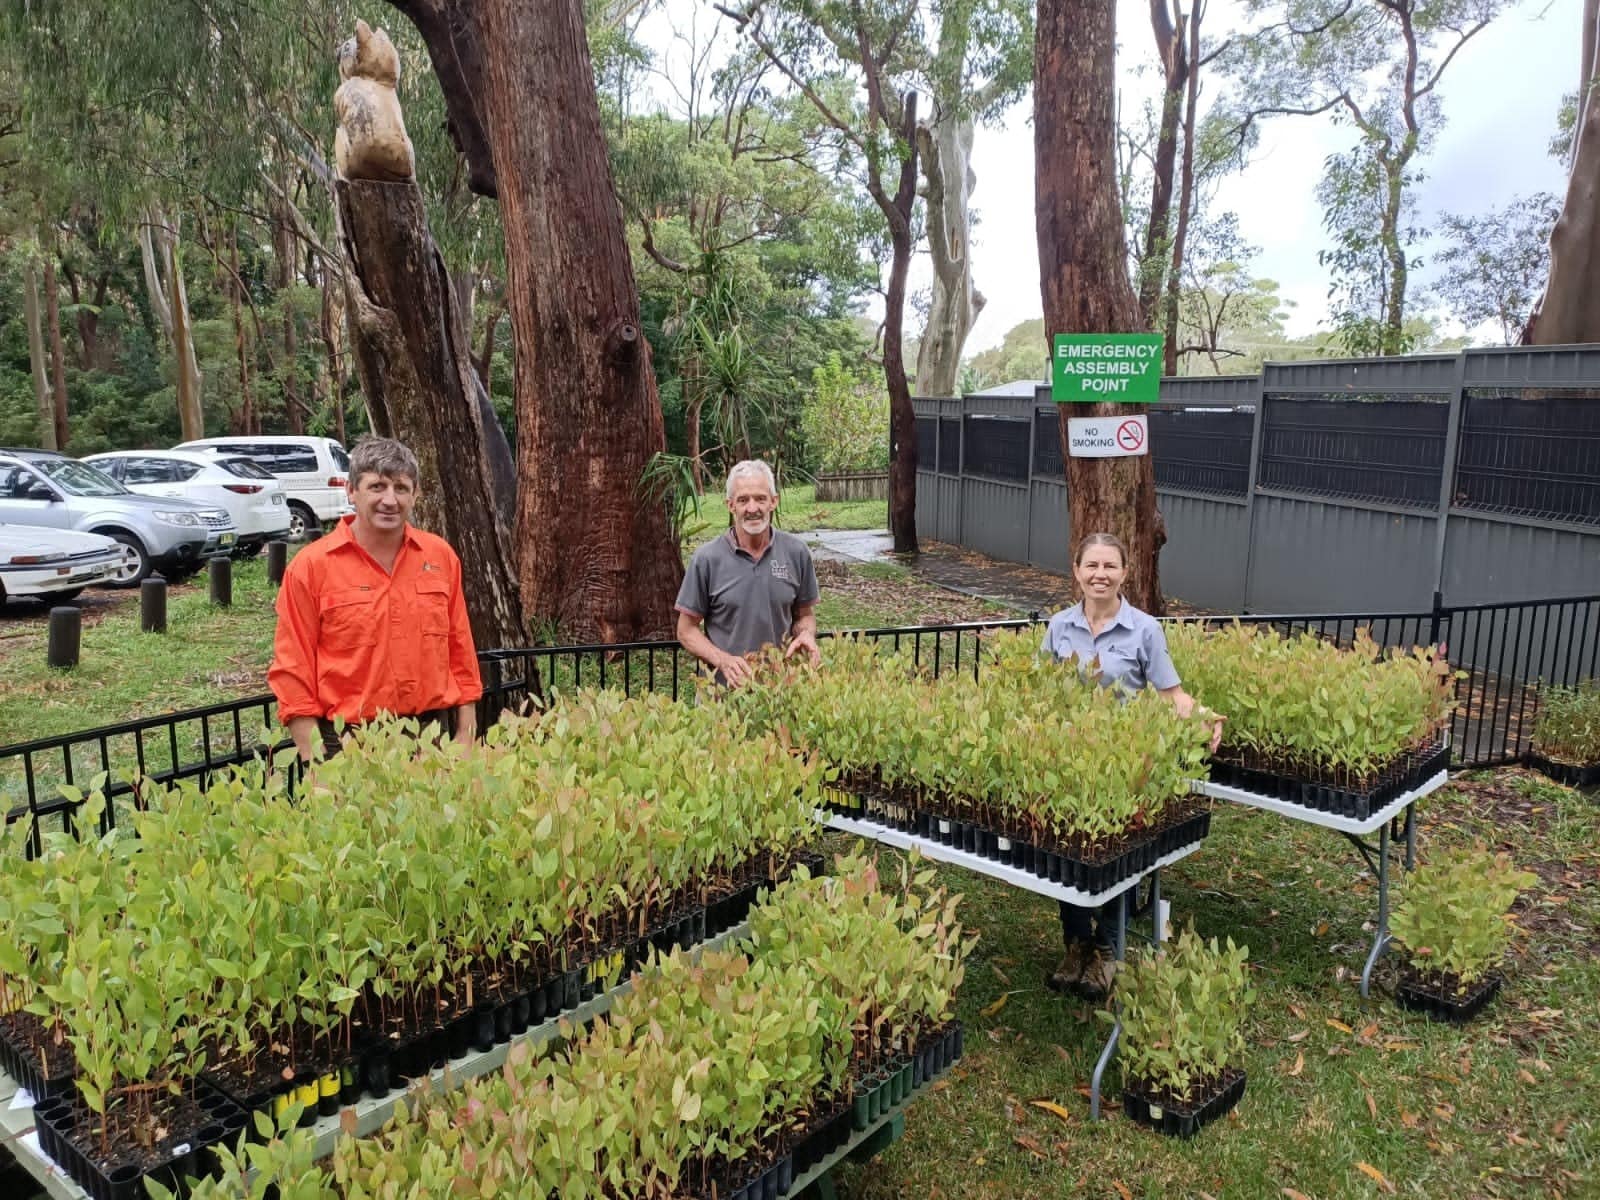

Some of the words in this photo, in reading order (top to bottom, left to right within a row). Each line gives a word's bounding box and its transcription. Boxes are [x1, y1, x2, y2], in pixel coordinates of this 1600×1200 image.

[1058, 345, 1158, 358] EMERGENCY
[1064, 362, 1149, 374] ASSEMBLY
[1082, 379, 1129, 391] POINT
[1085, 428, 1098, 436] NO
[1072, 438, 1115, 447] SMOKING
